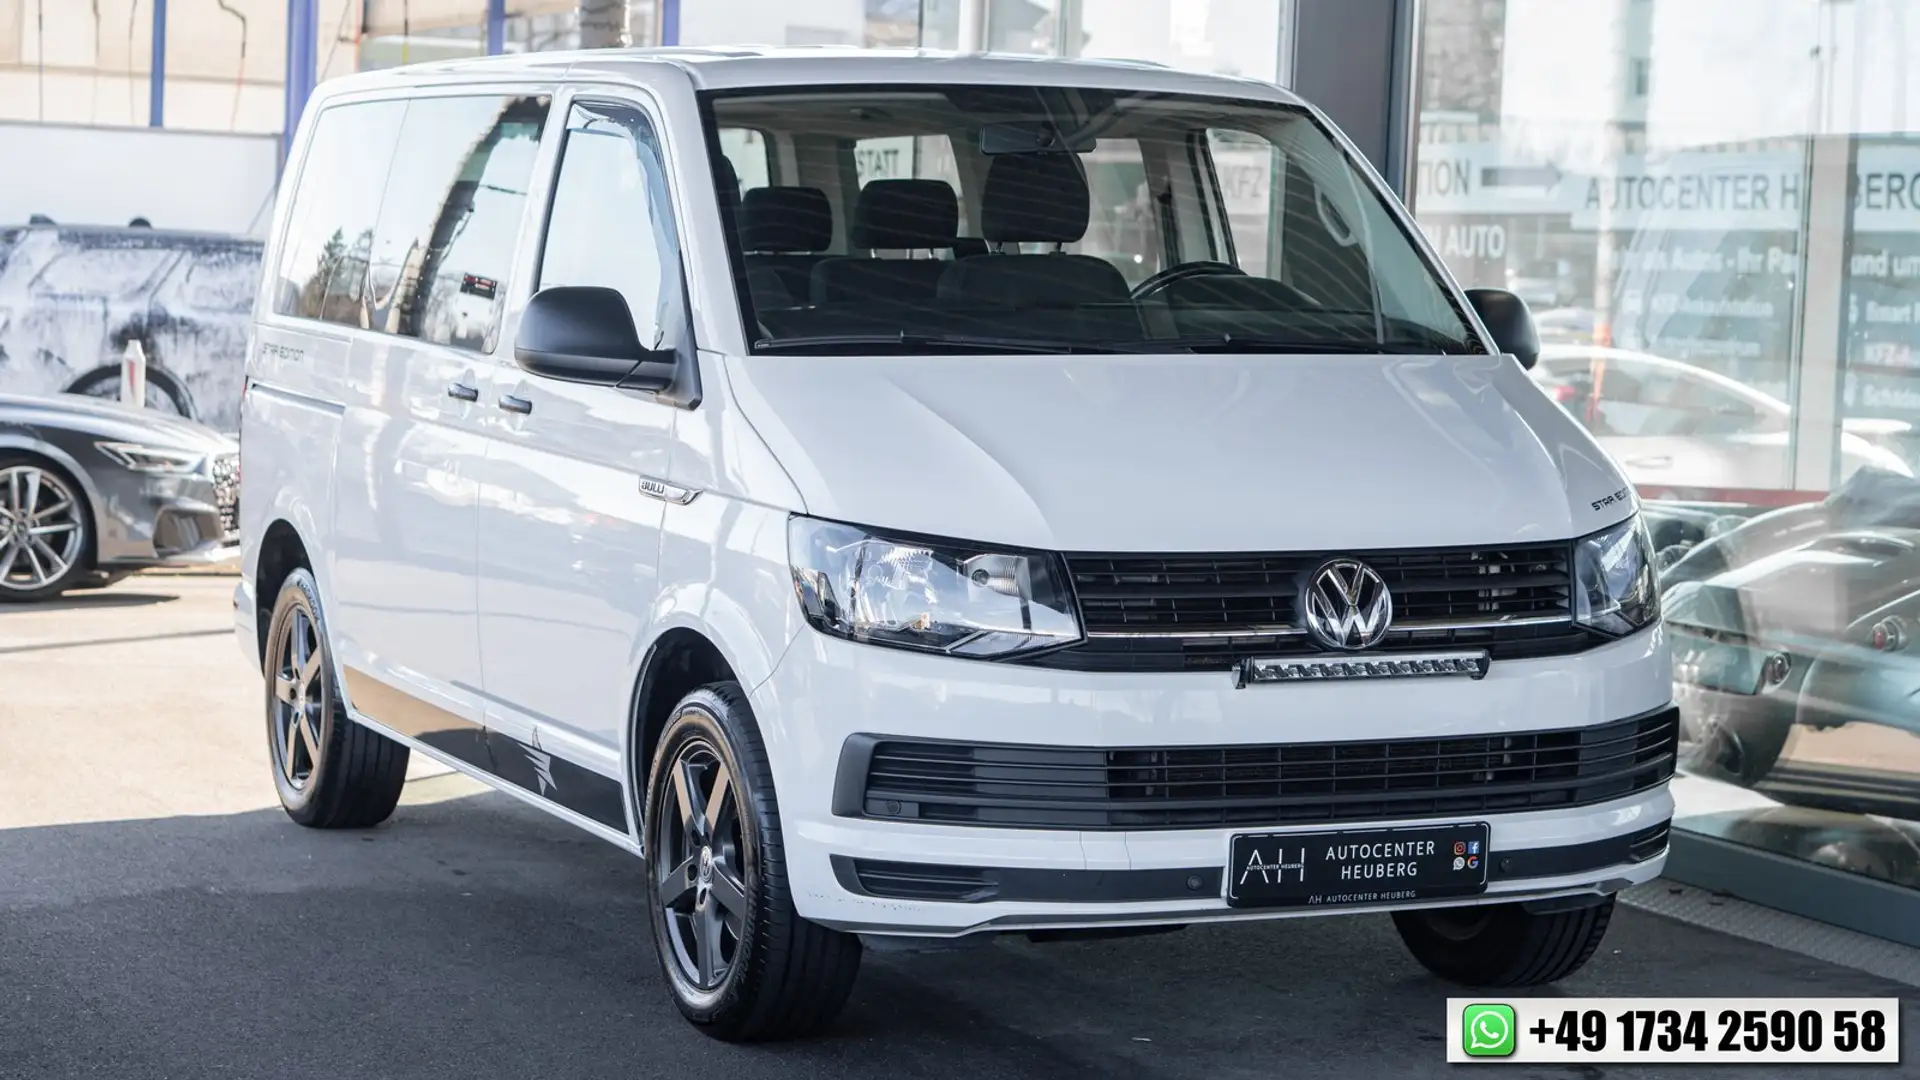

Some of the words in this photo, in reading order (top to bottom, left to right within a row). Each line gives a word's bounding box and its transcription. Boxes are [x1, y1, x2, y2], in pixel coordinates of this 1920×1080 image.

[1444, 223, 1506, 259] AUTO
[1591, 495, 1616, 511] STAR
[1325, 840, 1435, 861] AUTOCENTER
[1341, 861, 1418, 880] HEUBERG
[1326, 892, 1378, 903] AUTOCENTER
[1380, 890, 1416, 900] HEUBERG
